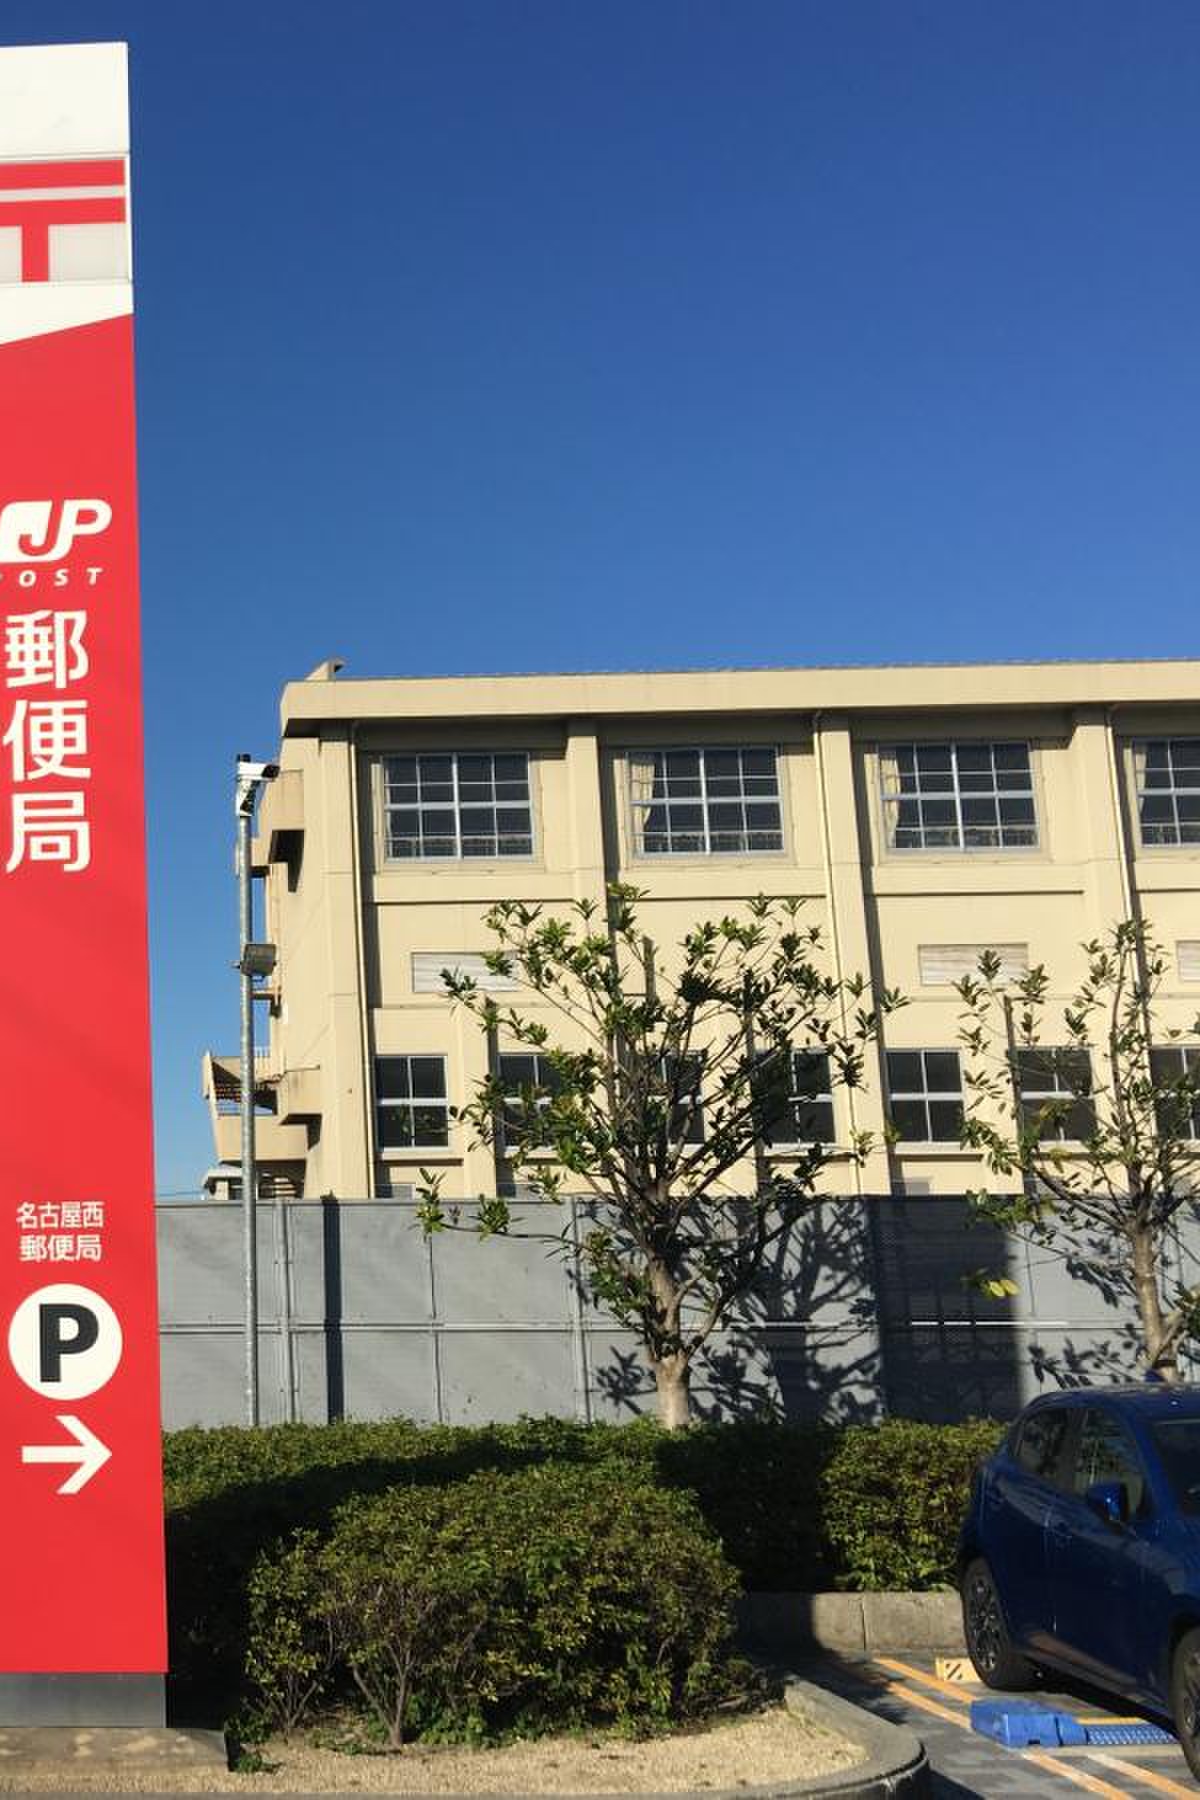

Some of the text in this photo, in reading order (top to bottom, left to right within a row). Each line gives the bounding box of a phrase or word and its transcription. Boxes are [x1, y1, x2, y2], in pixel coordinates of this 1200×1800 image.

[2, 609, 92, 873] 郵便局
[16, 1200, 105, 1230] 名古屋西
[18, 1233, 103, 1262] 郵便局
[39, 1303, 99, 1383] P
